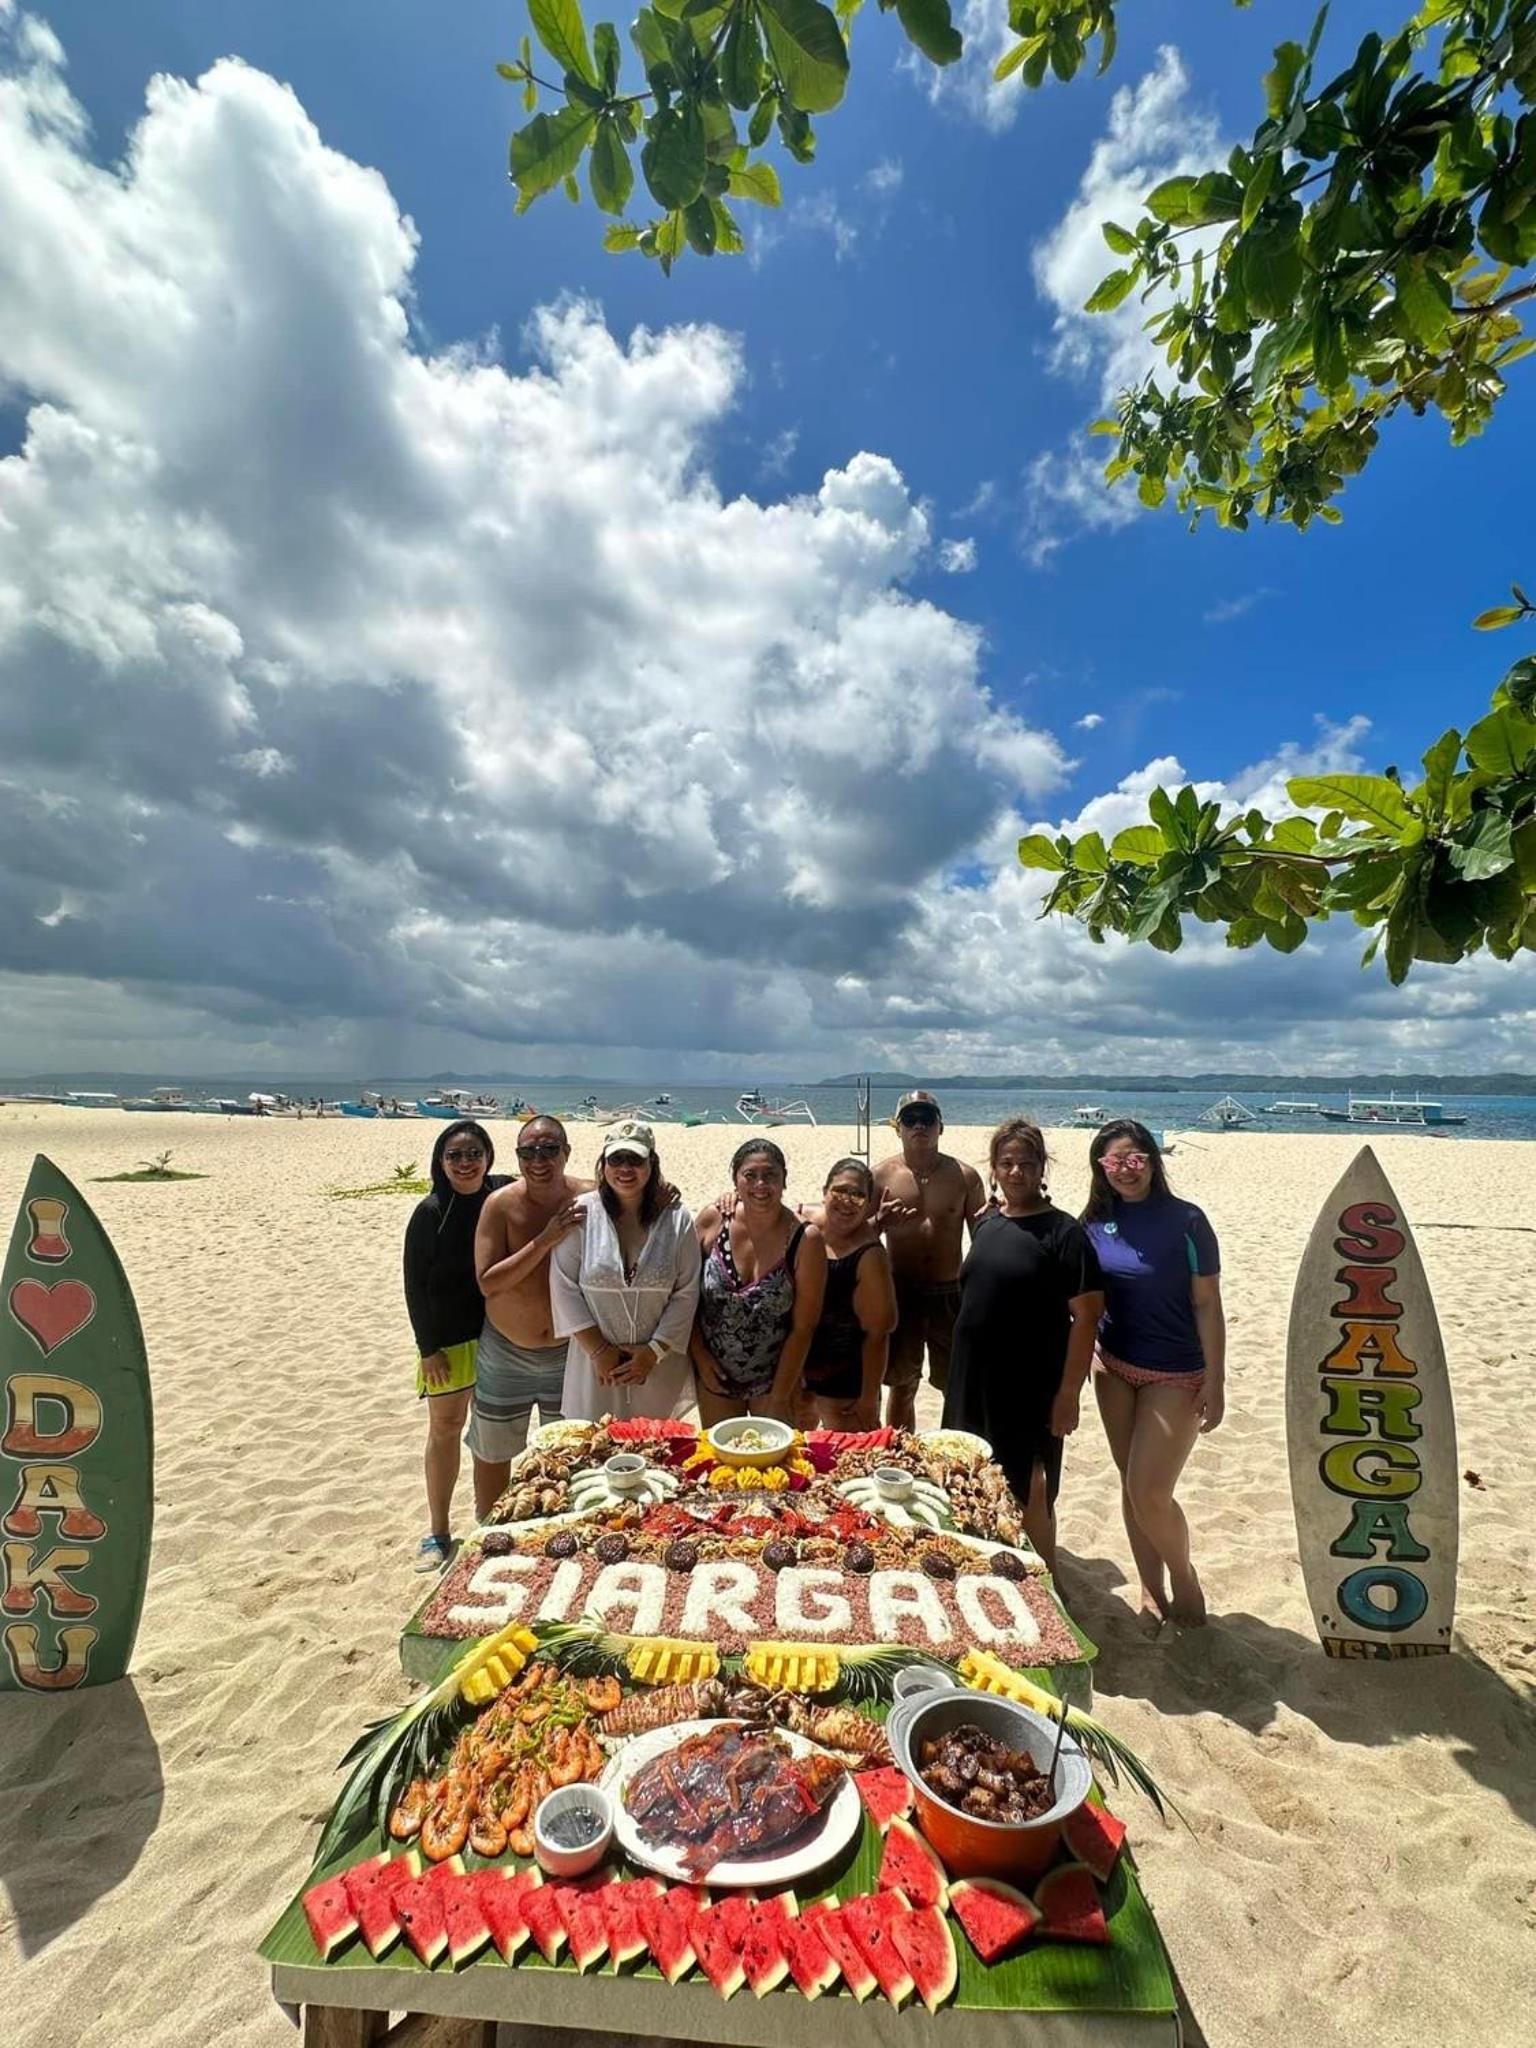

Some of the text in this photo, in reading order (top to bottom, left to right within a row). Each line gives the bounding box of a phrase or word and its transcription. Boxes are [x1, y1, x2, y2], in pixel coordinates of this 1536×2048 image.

[1, 1198, 107, 1691] I DAKU
[447, 1554, 1041, 1645] SIARGAO
[1317, 1202, 1431, 1632] SIARGAO
